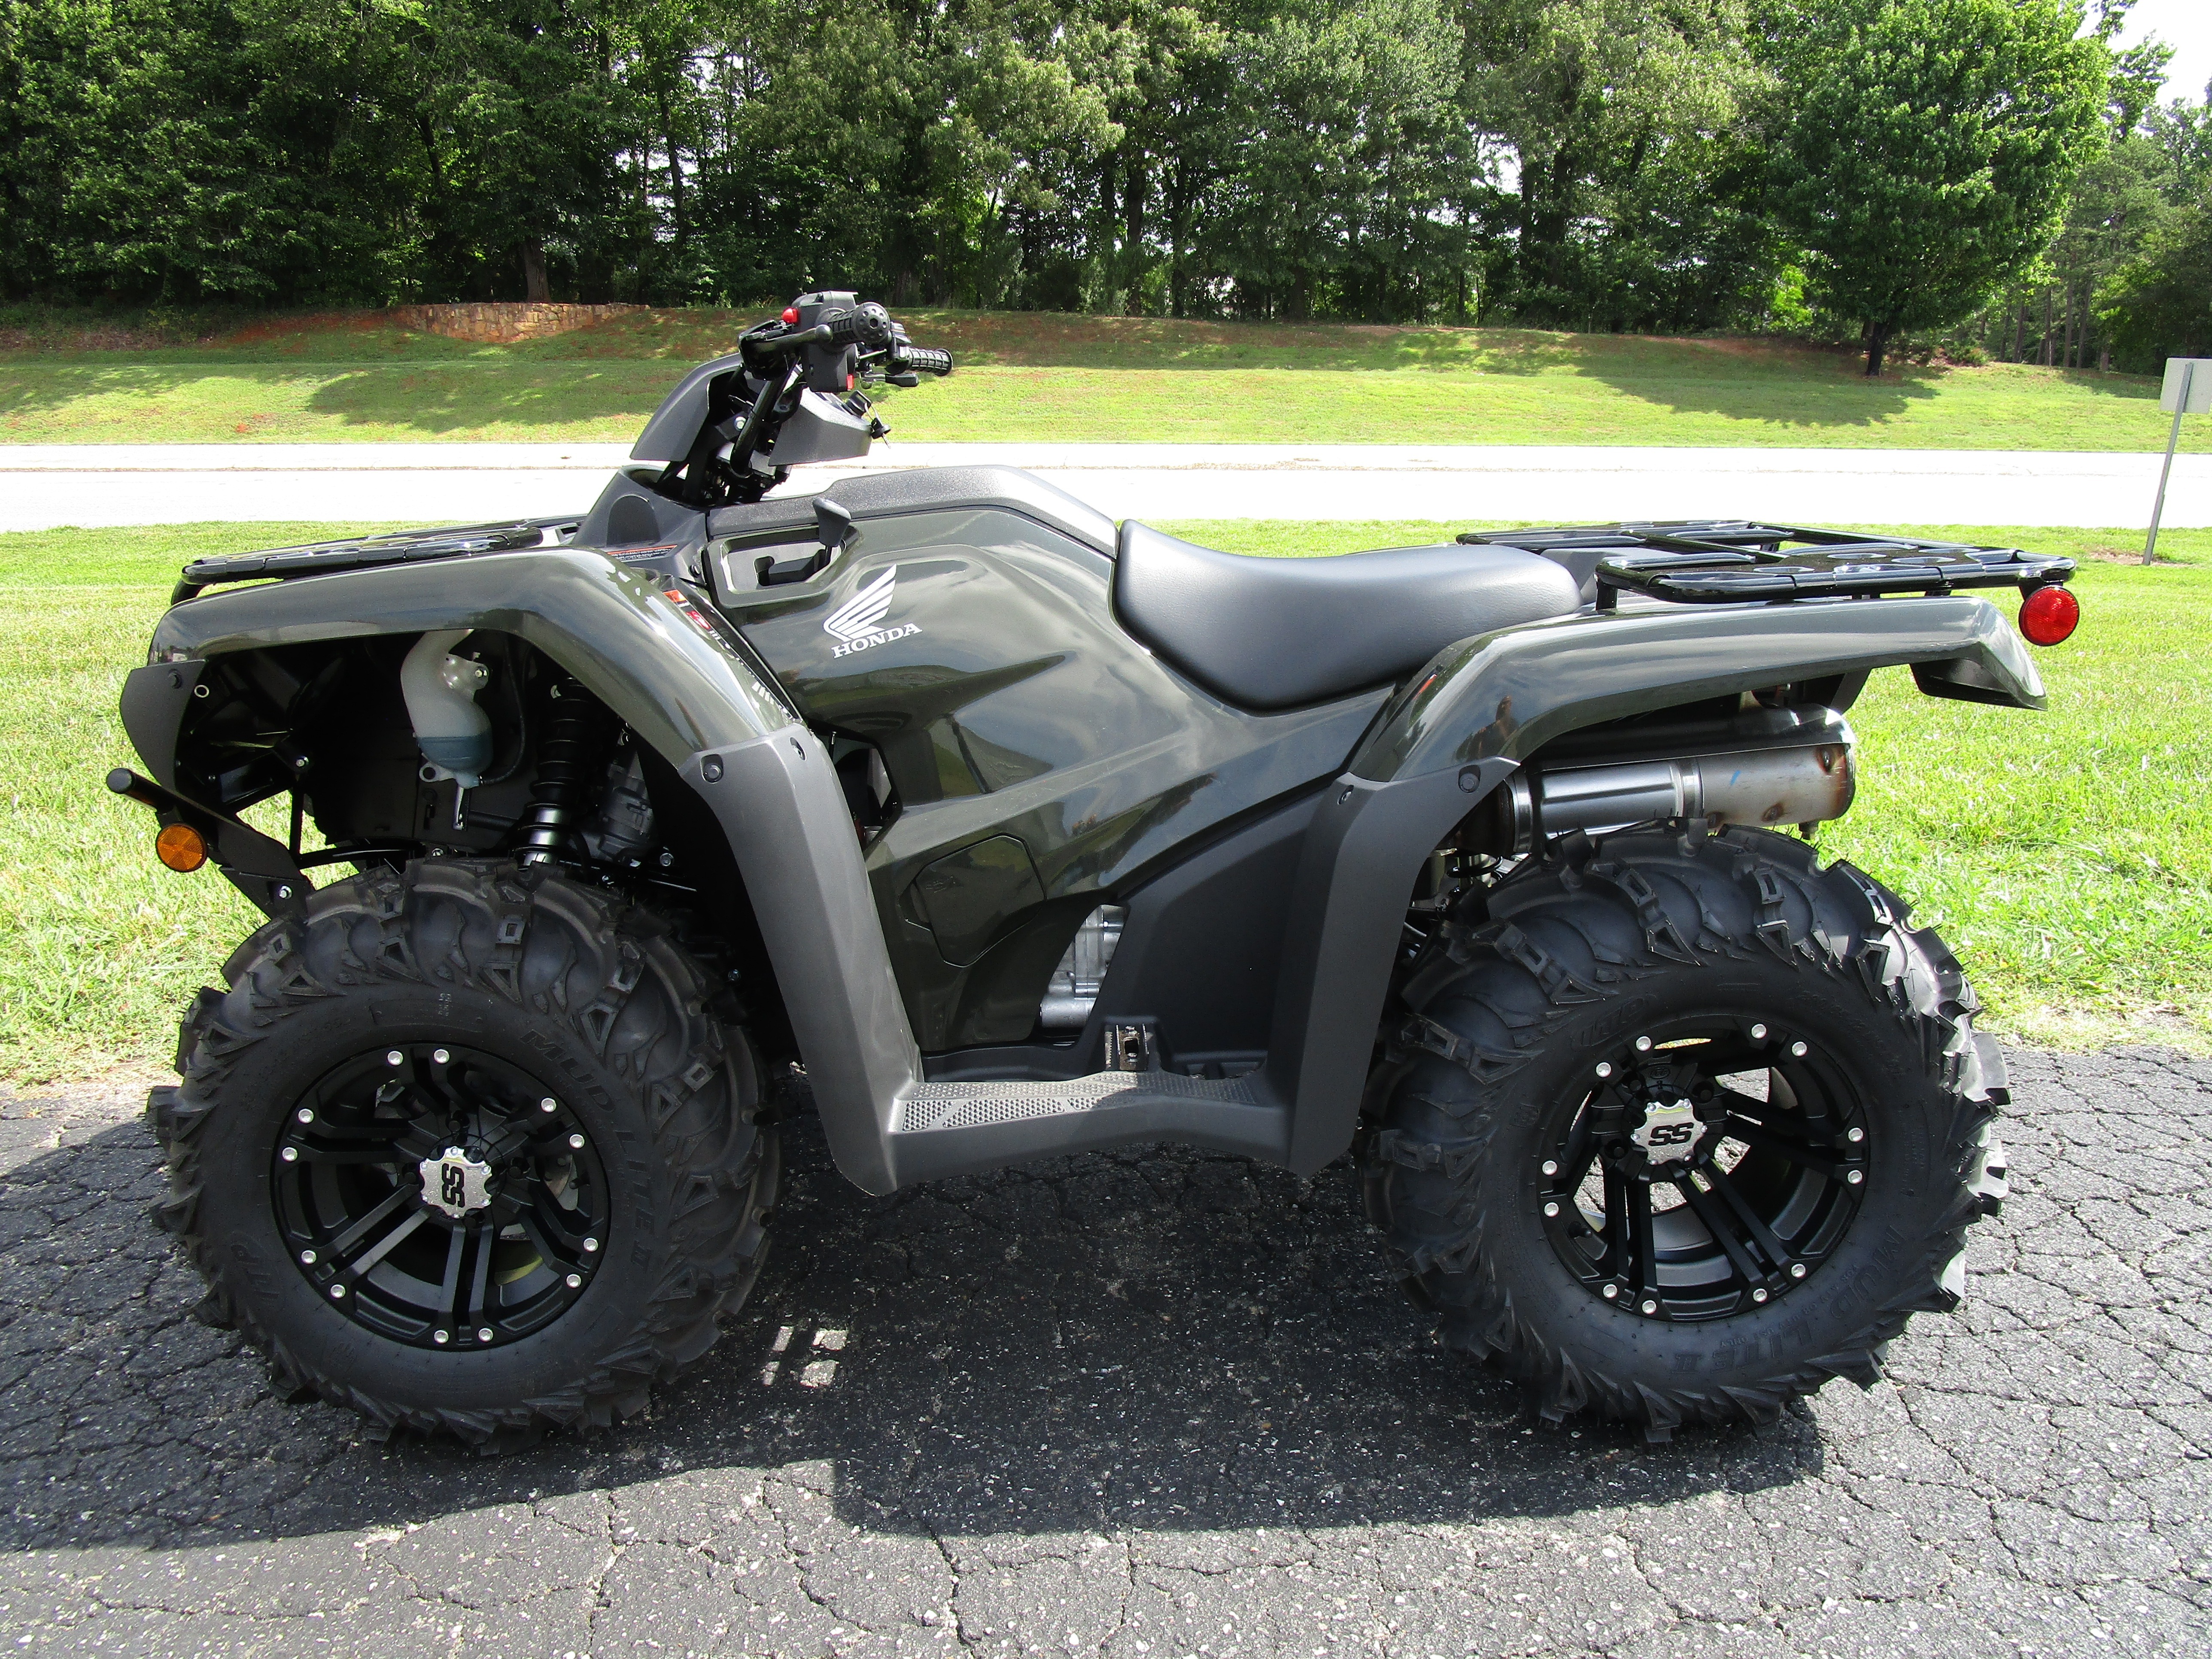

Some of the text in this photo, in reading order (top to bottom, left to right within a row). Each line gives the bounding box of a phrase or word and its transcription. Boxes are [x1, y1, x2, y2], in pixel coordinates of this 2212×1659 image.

[831, 622, 923, 659] HONDA
[518, 1029, 616, 1113] MUD
[1648, 1122, 1694, 1146] SS
[441, 1163, 465, 1208] SS
[1830, 1225, 1907, 1319] MUD
[1841, 1264, 1860, 1281] FOR
[1803, 1301, 1817, 1315] OR
[1711, 1320, 1814, 1374] LITE
[1720, 1334, 1749, 1348] ONLY
